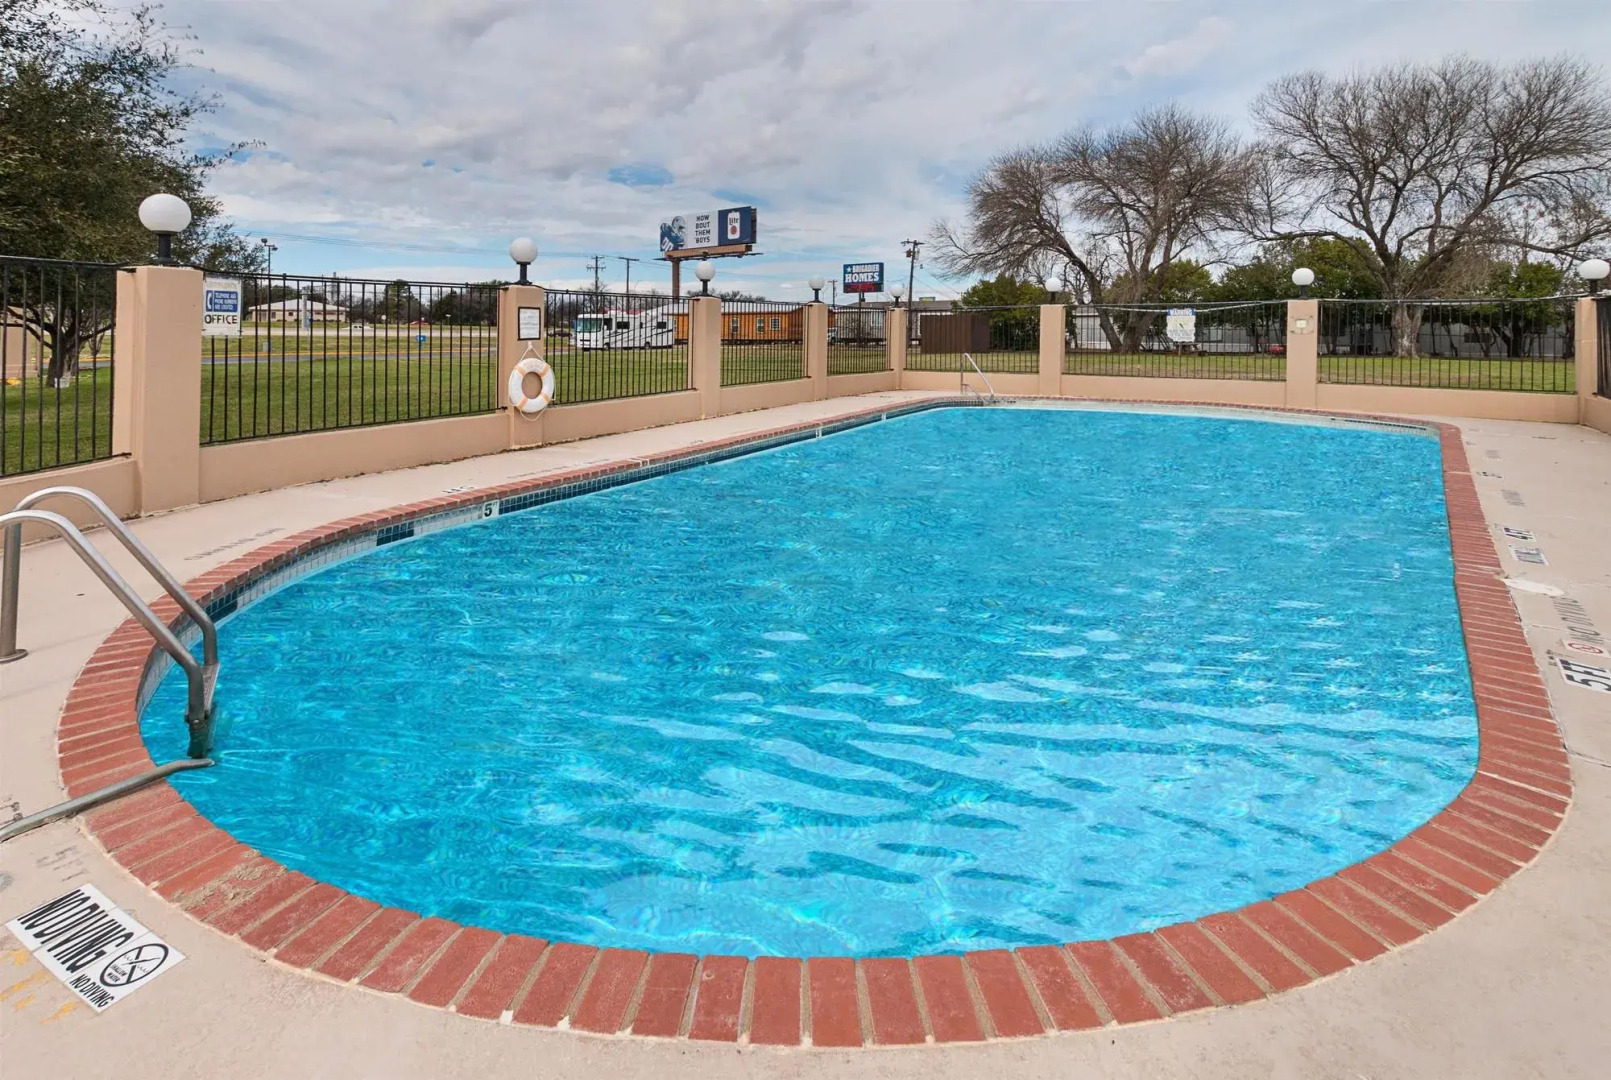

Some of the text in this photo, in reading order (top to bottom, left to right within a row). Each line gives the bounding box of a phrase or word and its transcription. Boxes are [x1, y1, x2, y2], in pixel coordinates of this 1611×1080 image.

[844, 272, 879, 283] HOMES
[204, 314, 238, 324] OFFICE
[483, 503, 493, 517] 5
[17, 889, 135, 974] NO DIVING
[69, 973, 115, 1008] NO DIVING
